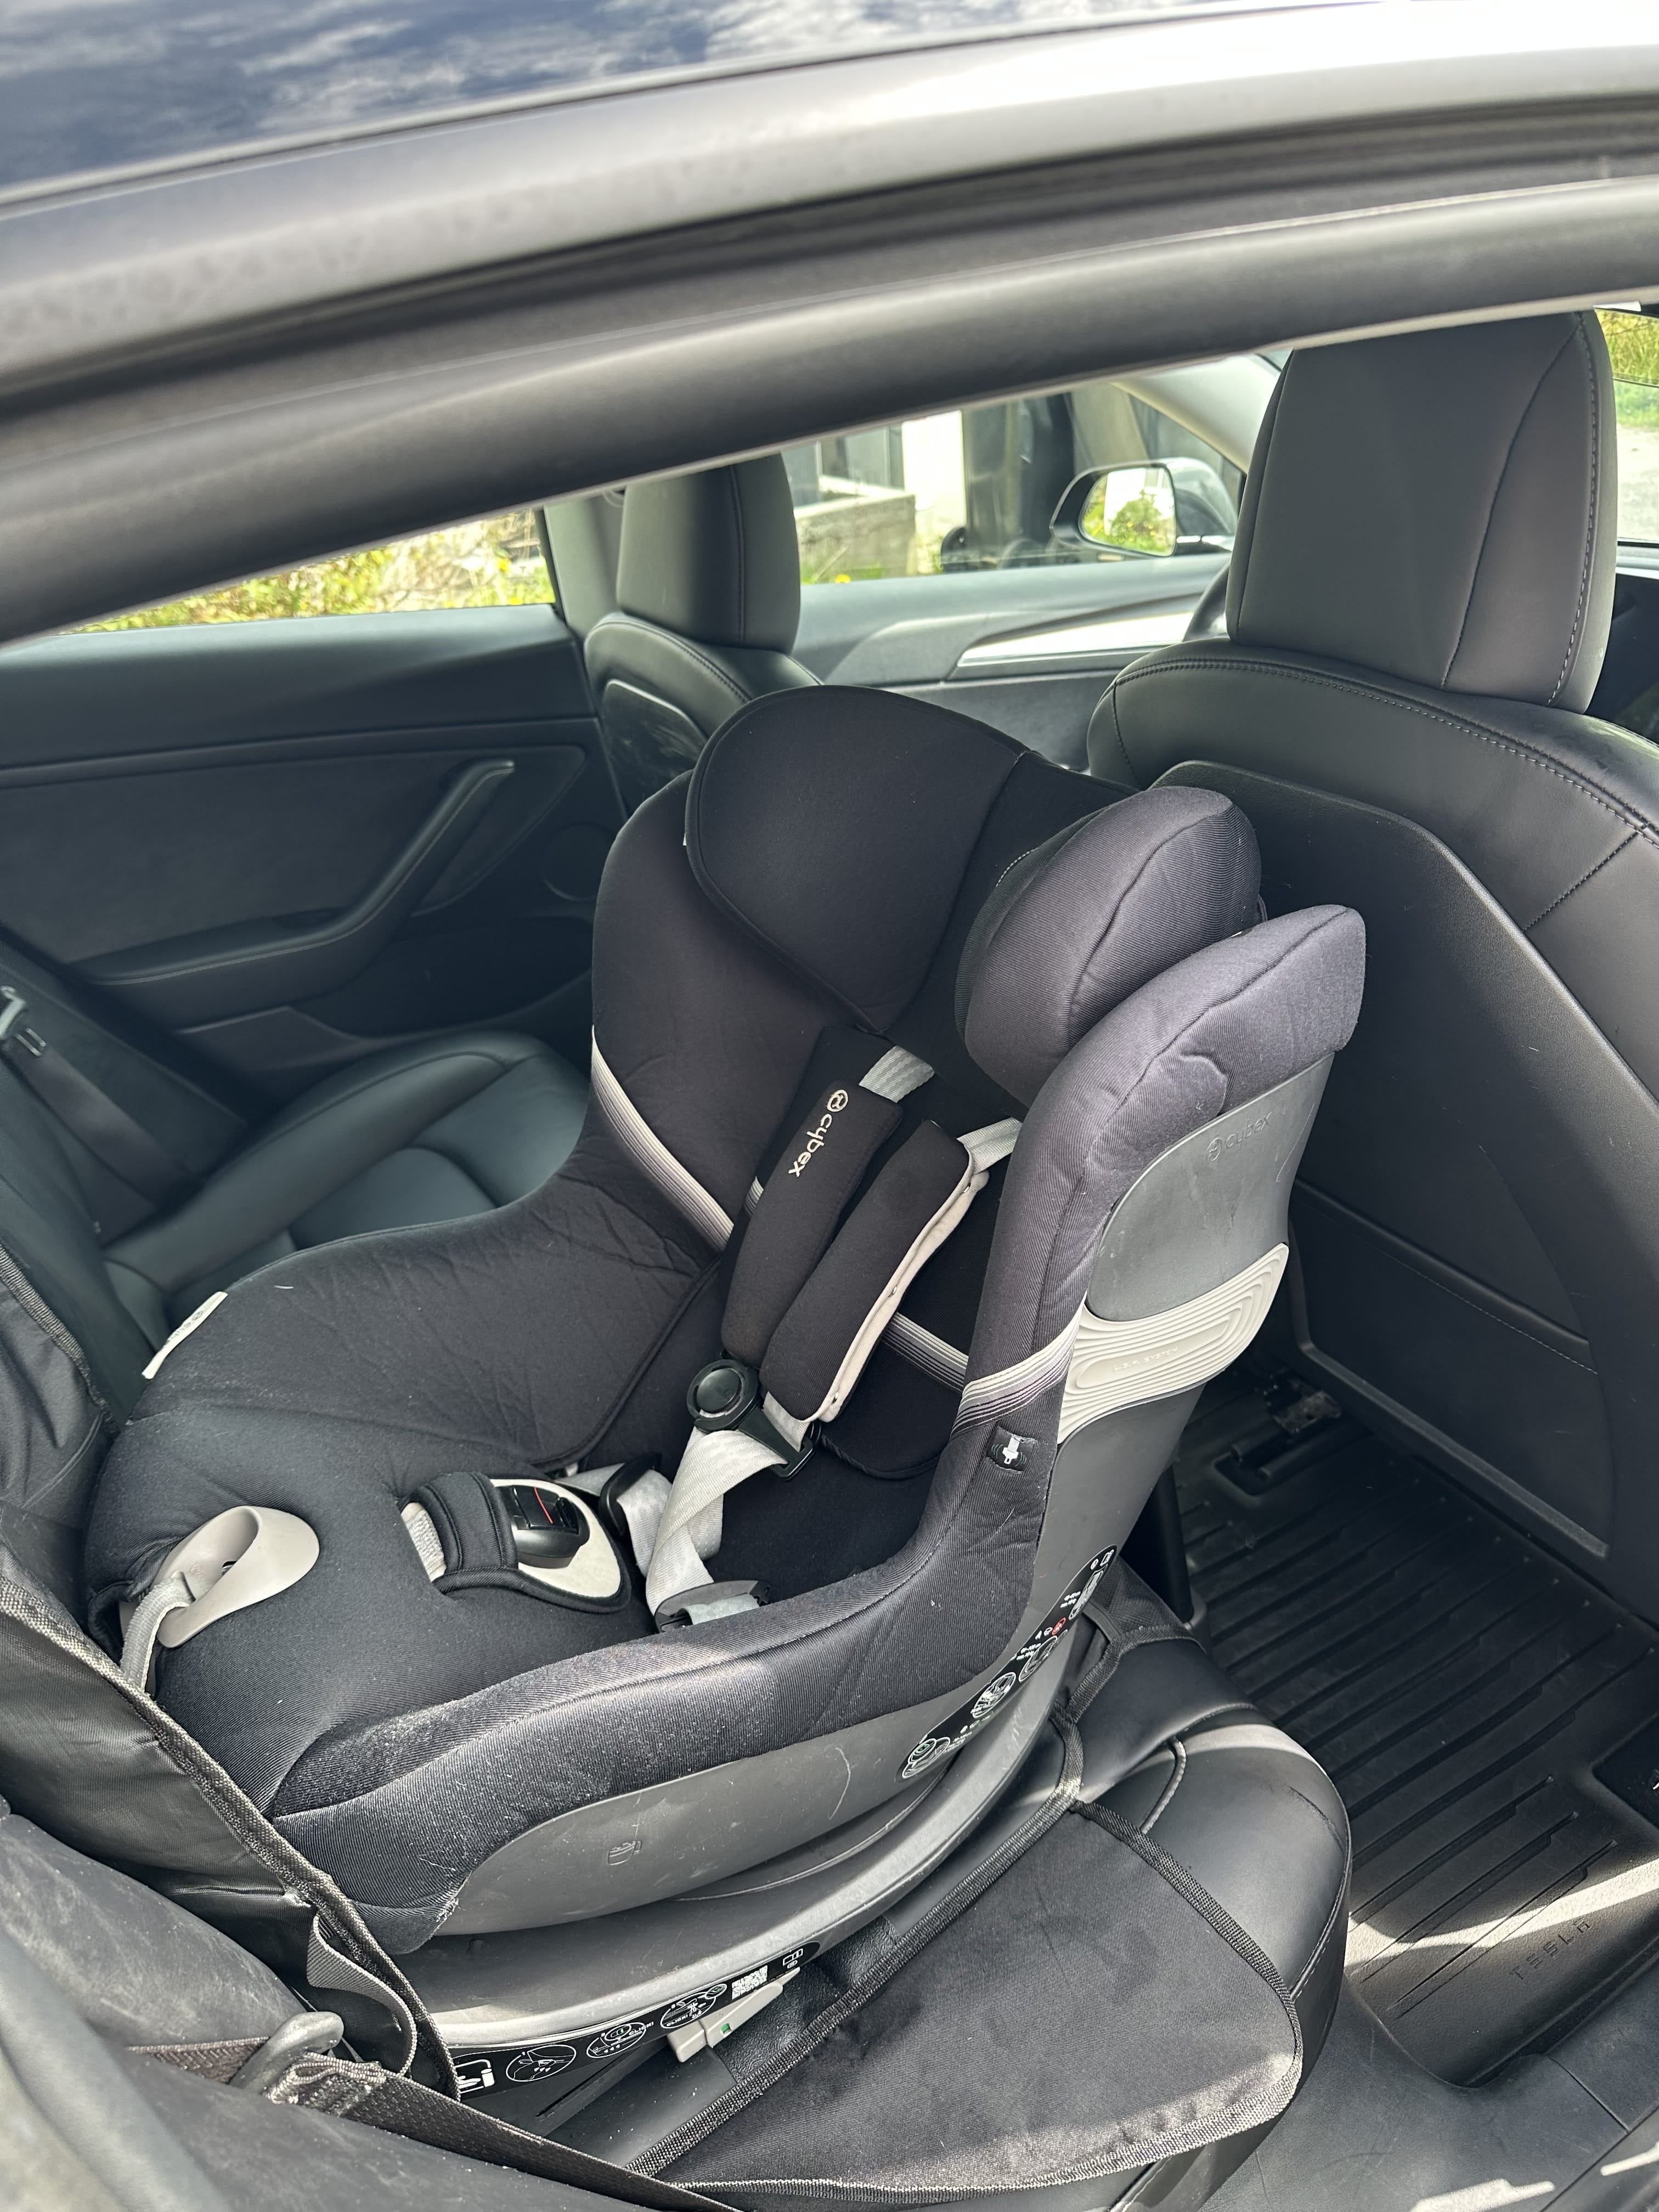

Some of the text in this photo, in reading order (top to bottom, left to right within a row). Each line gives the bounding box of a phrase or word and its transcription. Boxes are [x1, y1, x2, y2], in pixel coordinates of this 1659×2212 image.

[788, 1113, 832, 1177] cybex
[1225, 1111, 1272, 1150] cybex
[1142, 1347, 1178, 1364] SYSTEM
[1509, 1921, 1591, 1980] TESLA
